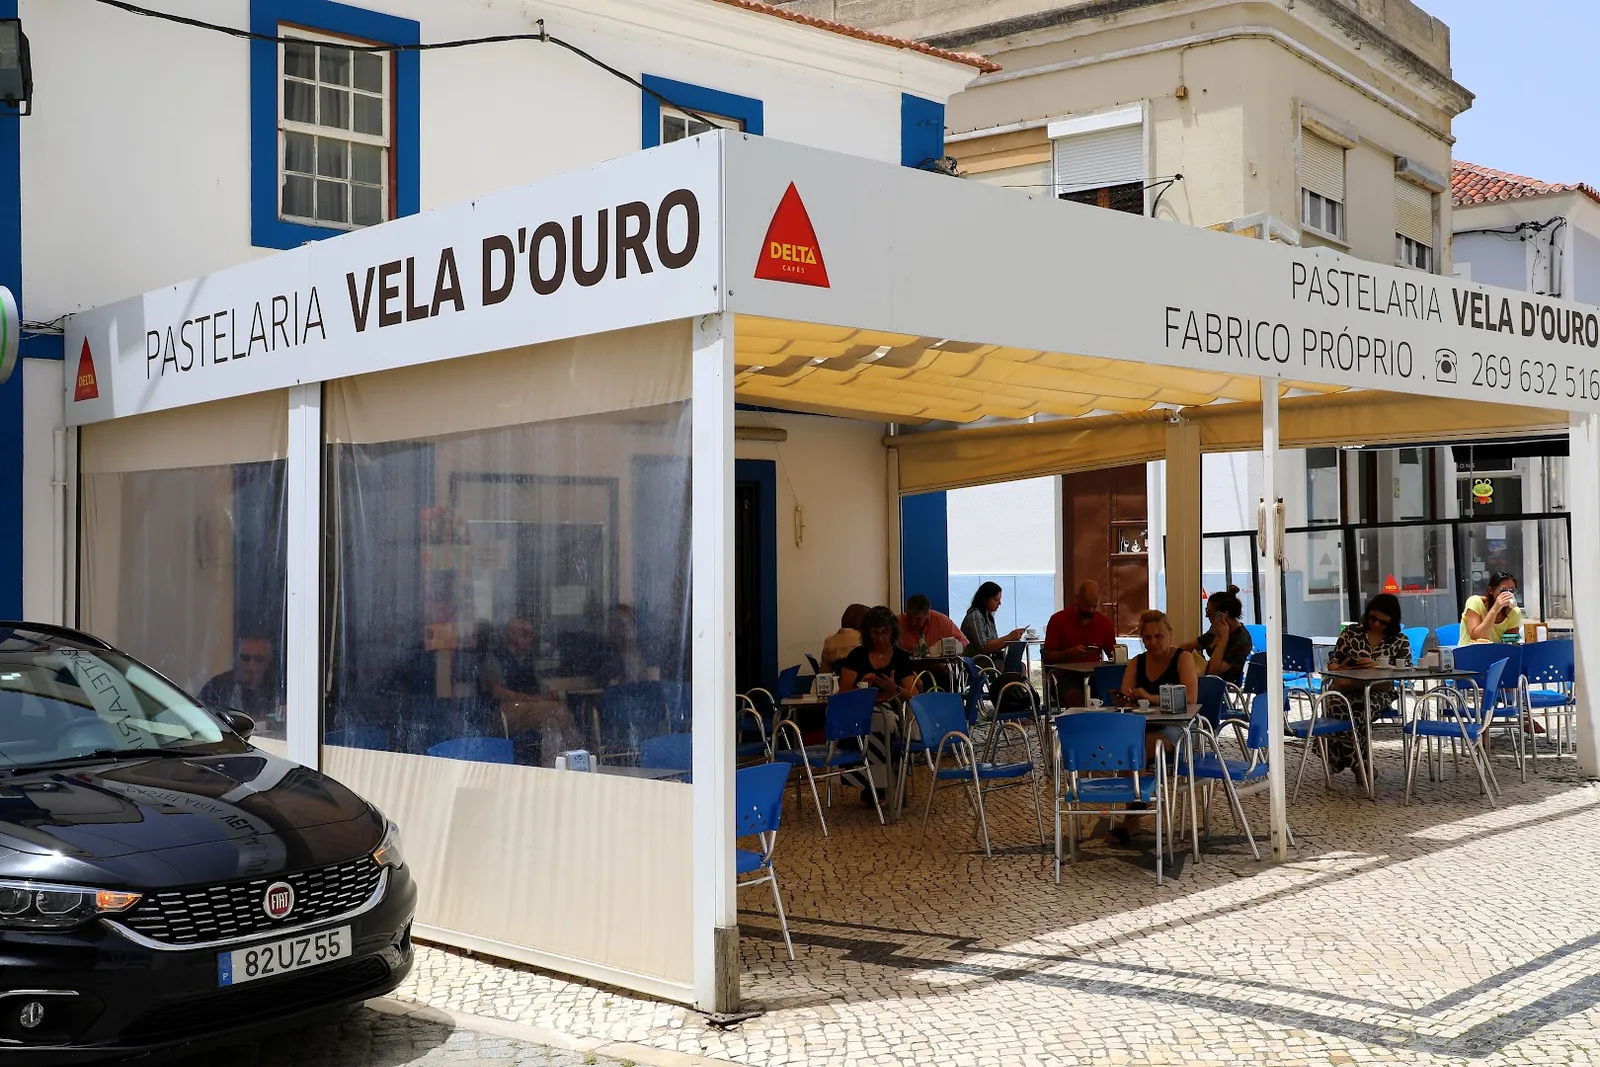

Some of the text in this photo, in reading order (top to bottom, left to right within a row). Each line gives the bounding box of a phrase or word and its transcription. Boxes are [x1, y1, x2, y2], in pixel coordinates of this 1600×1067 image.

[770, 241, 817, 264] DELTA
[782, 264, 805, 273] CAFÉS
[146, 189, 700, 379] PASTELARIA VELA D'OURO
[1292, 261, 1599, 348] PASTELARIA VELA D'OURO
[1165, 306, 1290, 363] FABRICO
[1303, 326, 1413, 378] PRÓPRIO
[1472, 352, 1511, 389] 269
[1520, 359, 1557, 395] 632
[1566, 365, 1600, 400] 516
[78, 374, 95, 387] DELTA
[271, 892, 289, 910] FIAT
[222, 931, 340, 980] P 82UZ55
